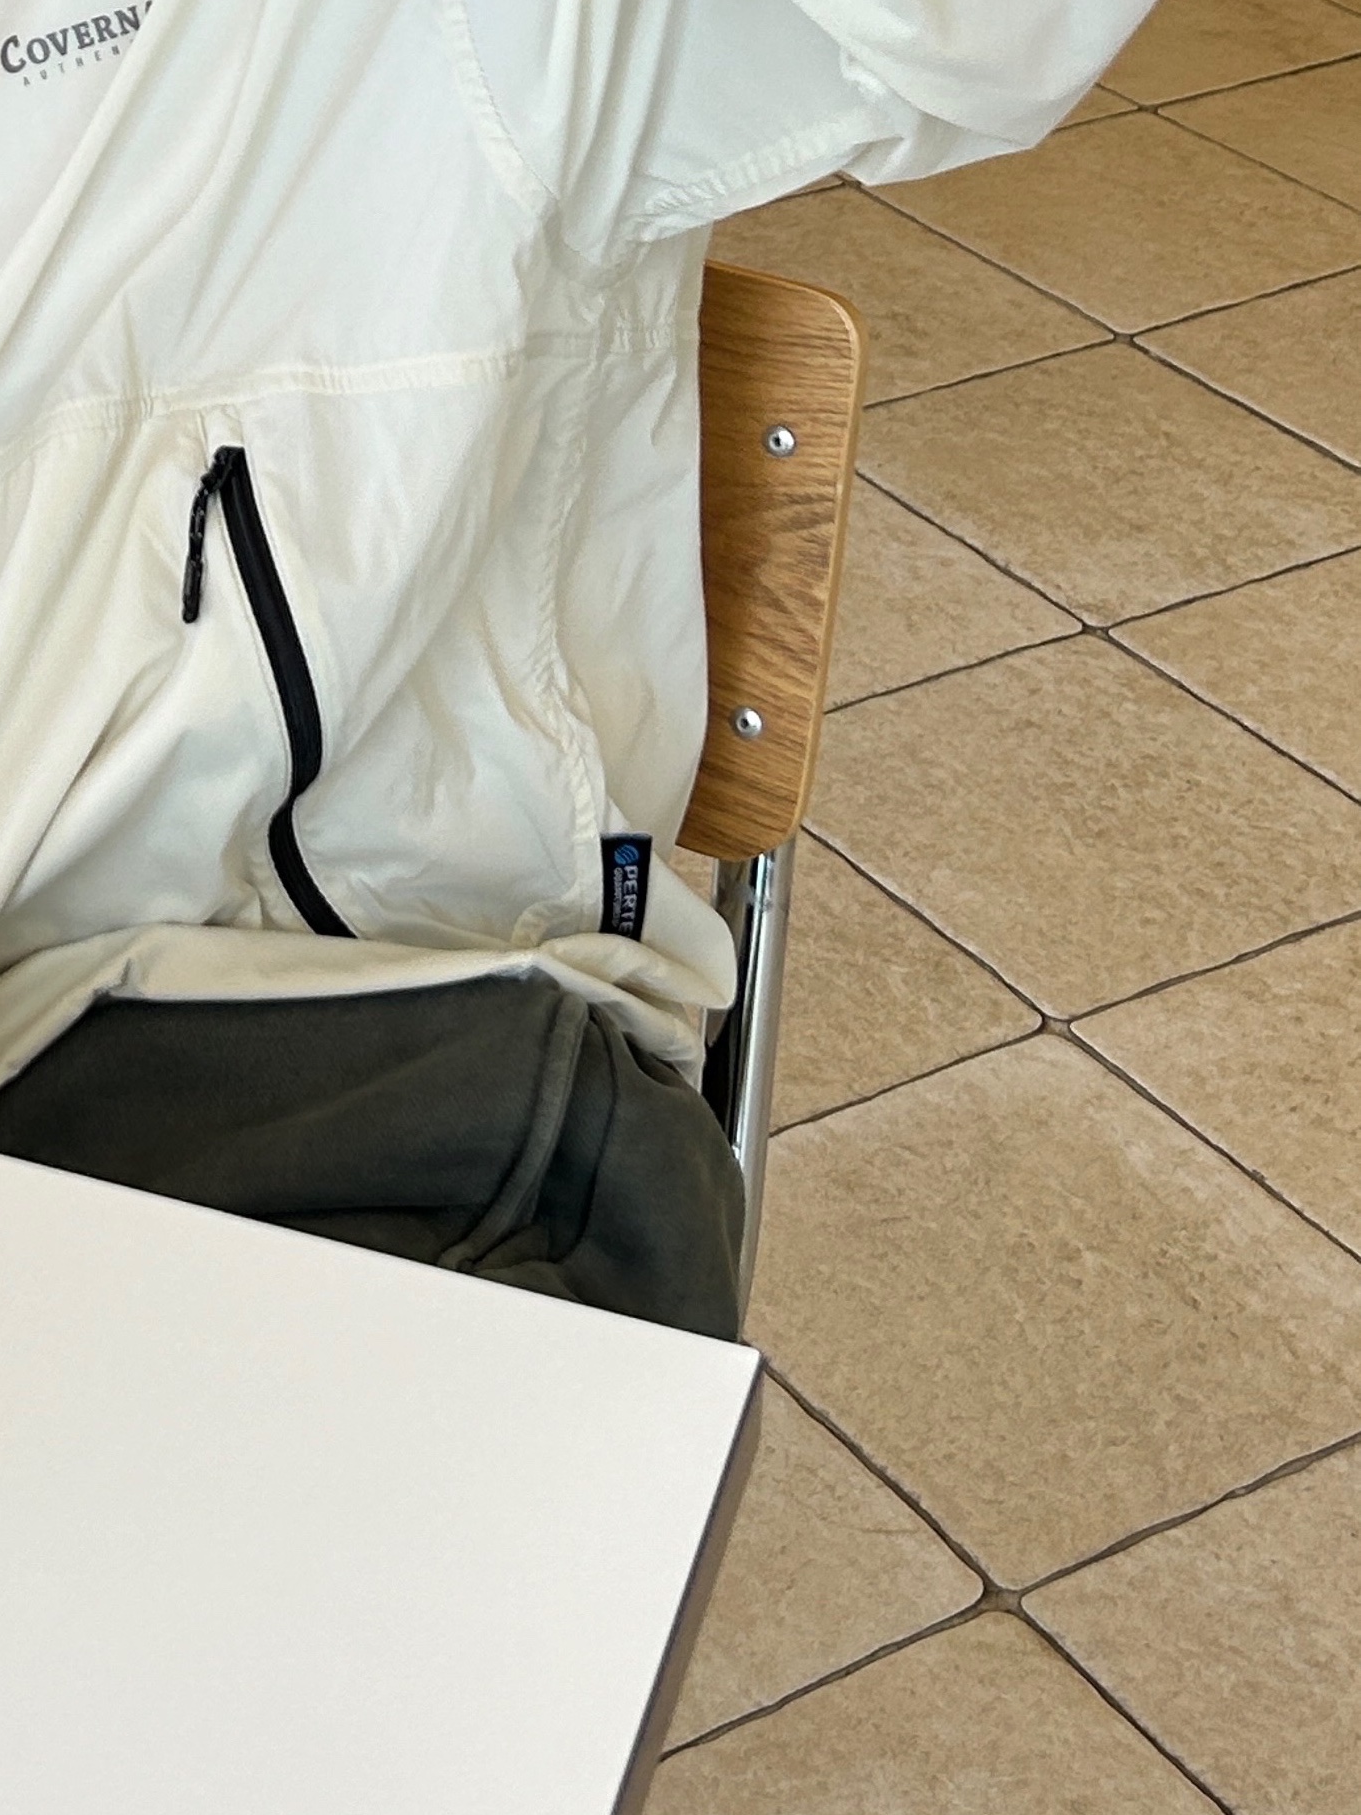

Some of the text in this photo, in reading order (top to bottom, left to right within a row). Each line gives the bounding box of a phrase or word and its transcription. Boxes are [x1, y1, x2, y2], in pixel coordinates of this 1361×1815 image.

[0, 0, 153, 74] COVERN
[22, 38, 135, 87] AUTHEN
[619, 865, 639, 936] PERTE
